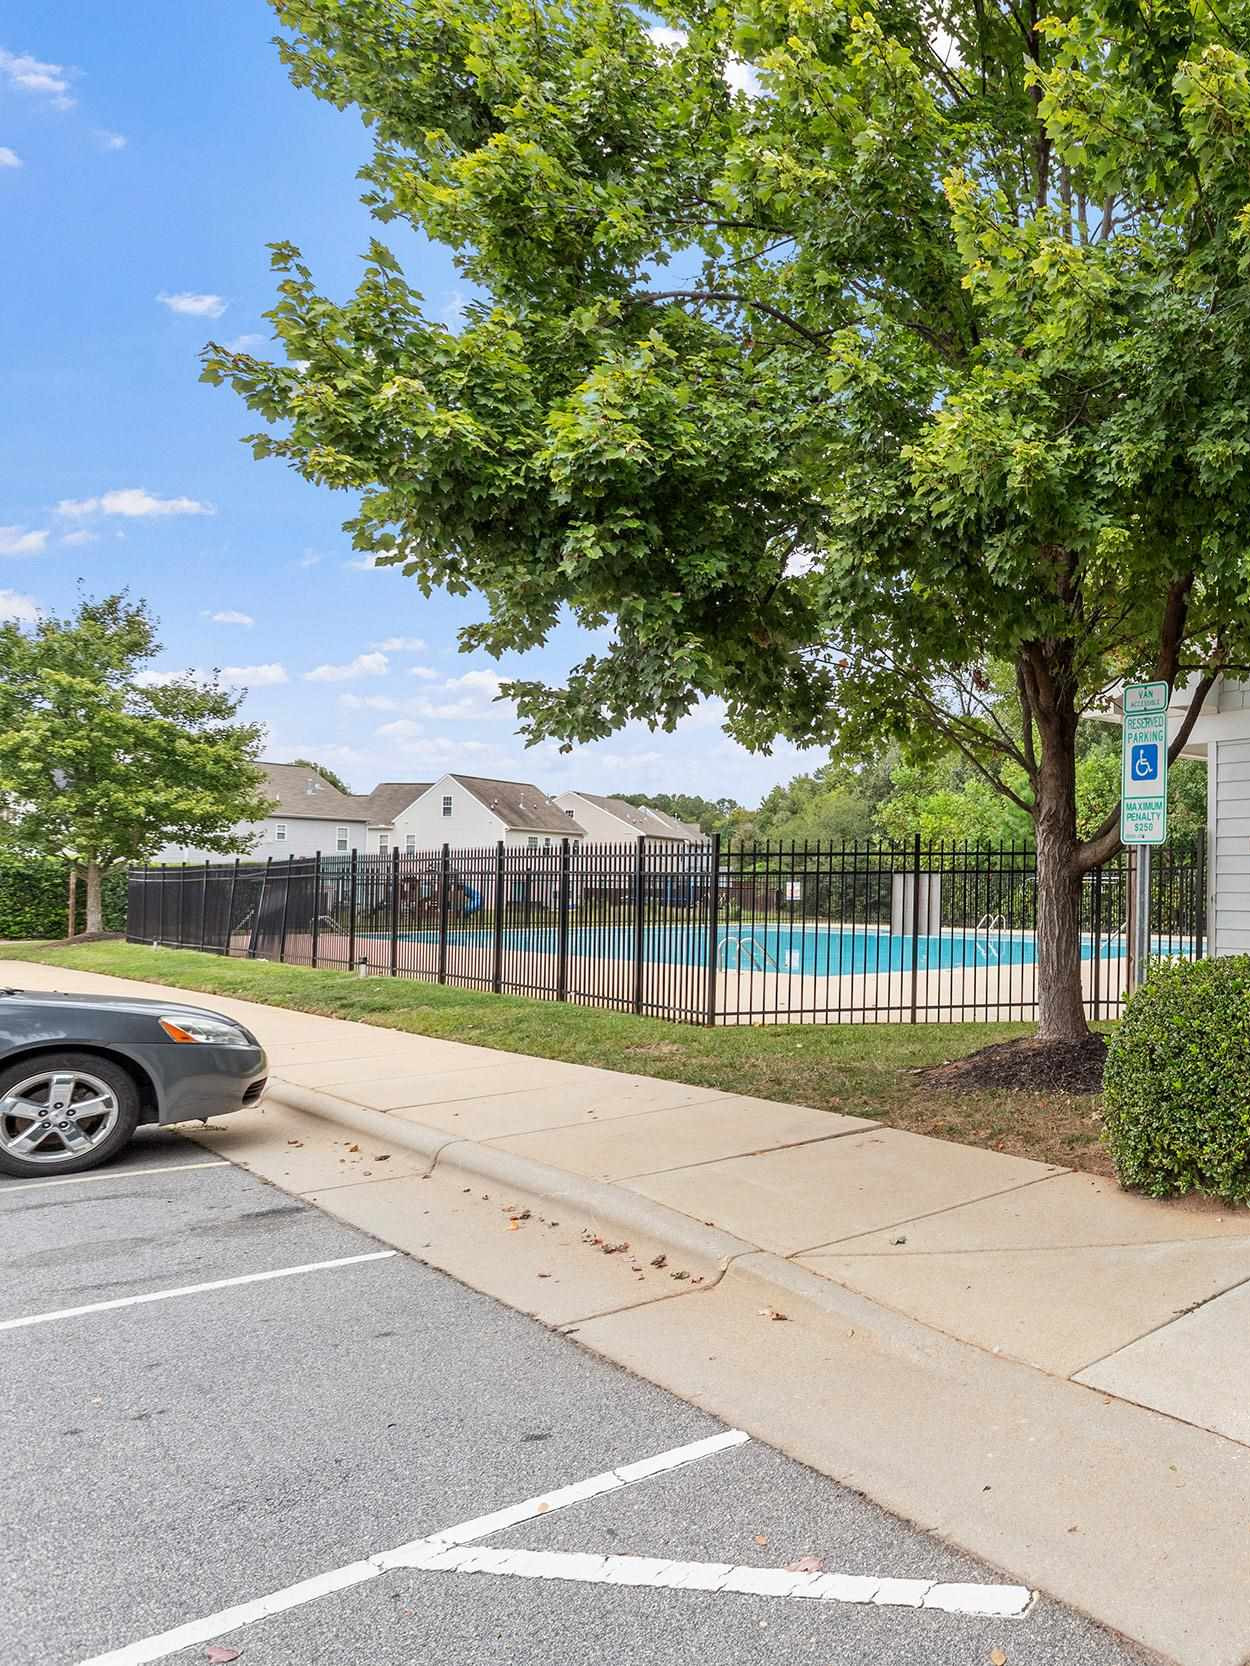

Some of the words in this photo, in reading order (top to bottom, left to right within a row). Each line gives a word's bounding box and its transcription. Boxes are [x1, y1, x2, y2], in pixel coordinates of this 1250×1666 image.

[1139, 690, 1153, 699] VAN
[1128, 717, 1163, 729] RESERVED
[1128, 731, 1163, 743] PARKING
[1126, 802, 1162, 811] MAXIMUM
[1127, 812, 1161, 821] PENALTY
[1134, 823, 1153, 832] $250
